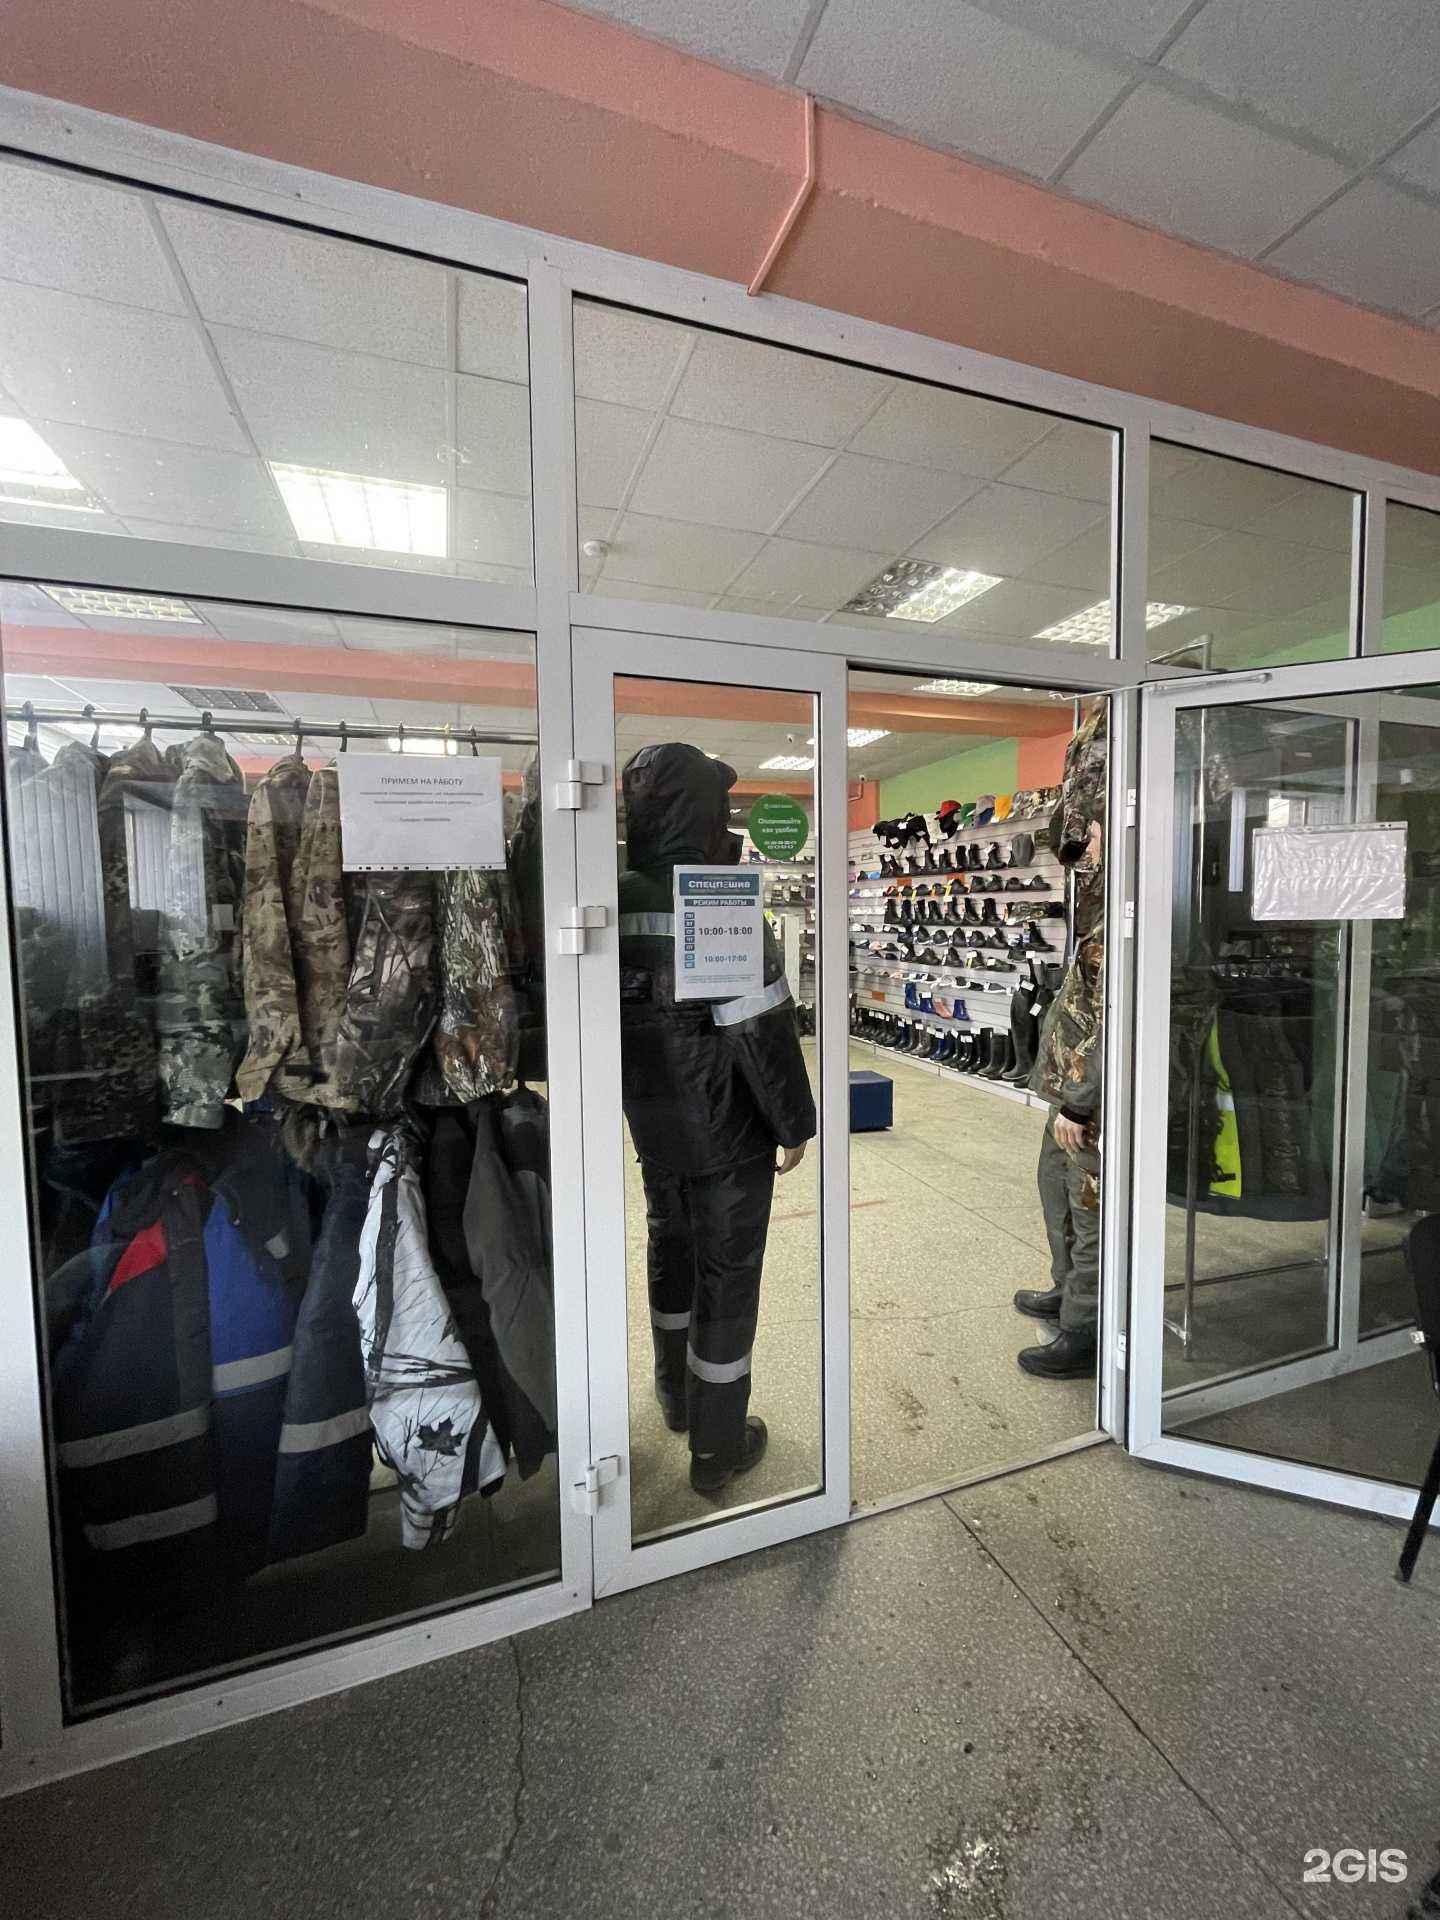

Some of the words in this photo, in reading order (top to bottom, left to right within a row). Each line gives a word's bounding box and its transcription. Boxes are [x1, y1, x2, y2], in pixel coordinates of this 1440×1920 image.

[381, 777, 419, 785] ПРИМЕМ
[420, 777, 432, 785] НА
[433, 777, 464, 786] РАБОТУ
